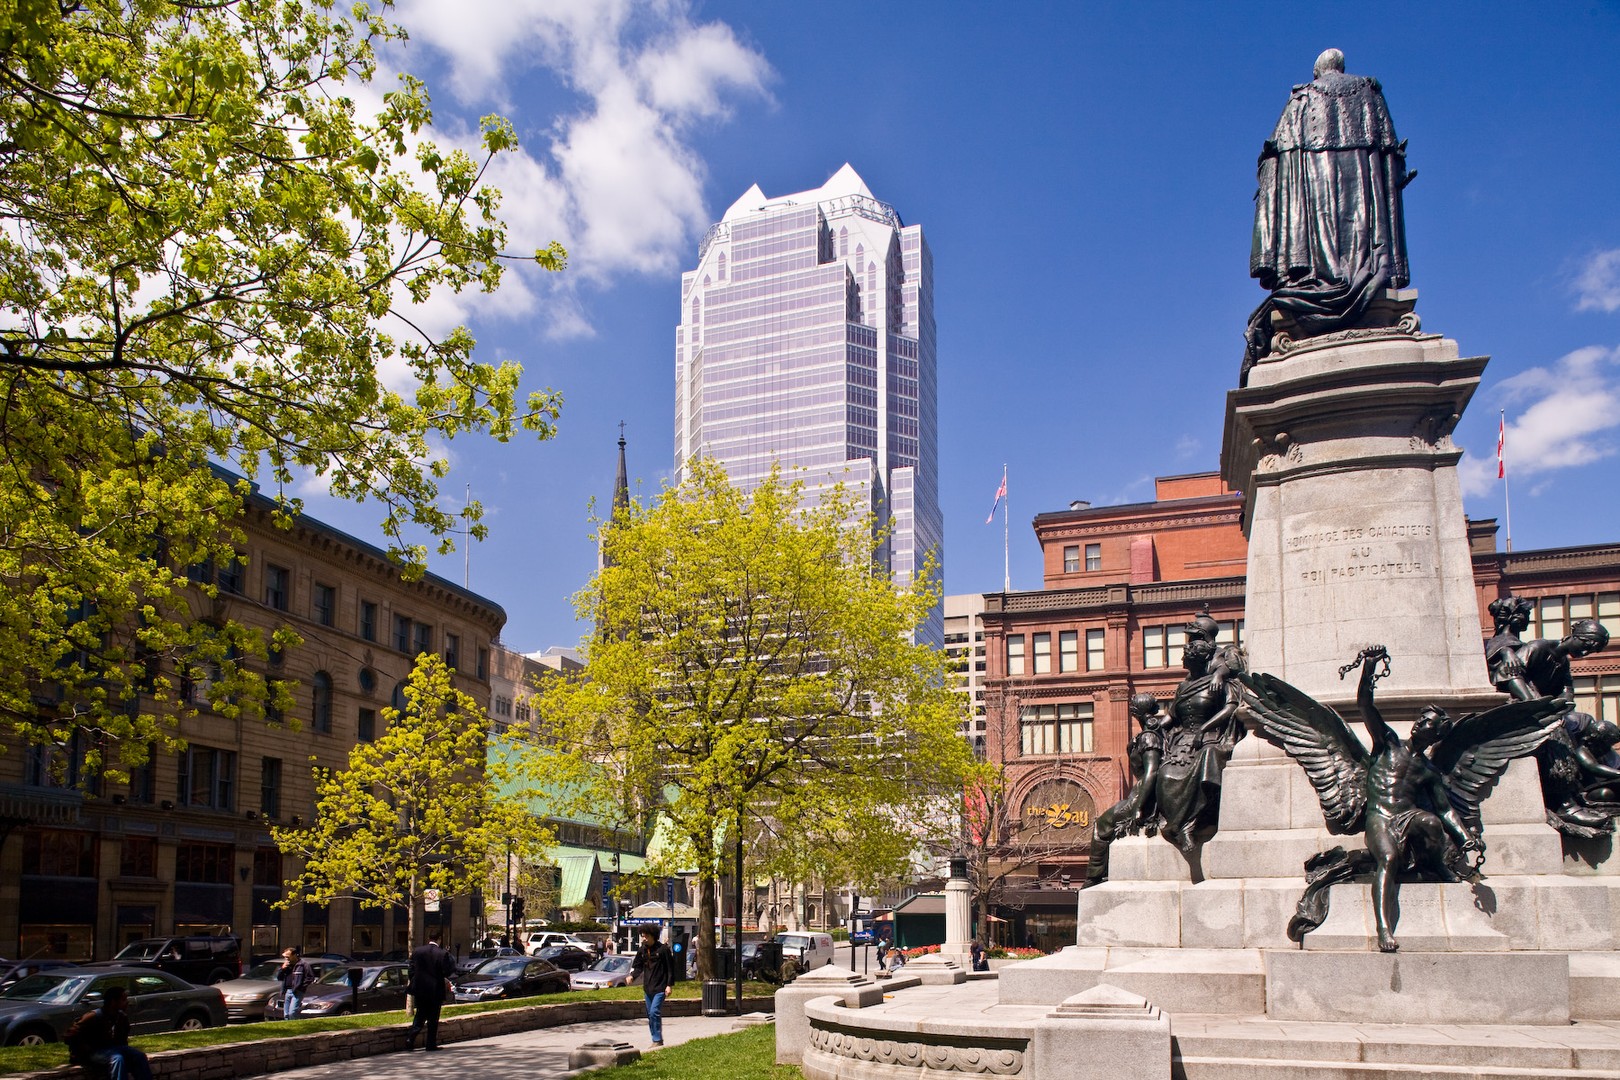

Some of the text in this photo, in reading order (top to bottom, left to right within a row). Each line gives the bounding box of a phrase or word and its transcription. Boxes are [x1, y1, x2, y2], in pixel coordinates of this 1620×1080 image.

[1286, 525, 1431, 547] HOMMAGE DES CANADIENS
[1351, 547, 1370, 558] AU
[1301, 562, 1422, 581] ROI PACIFICATEUR
[1027, 804, 1046, 816] the
